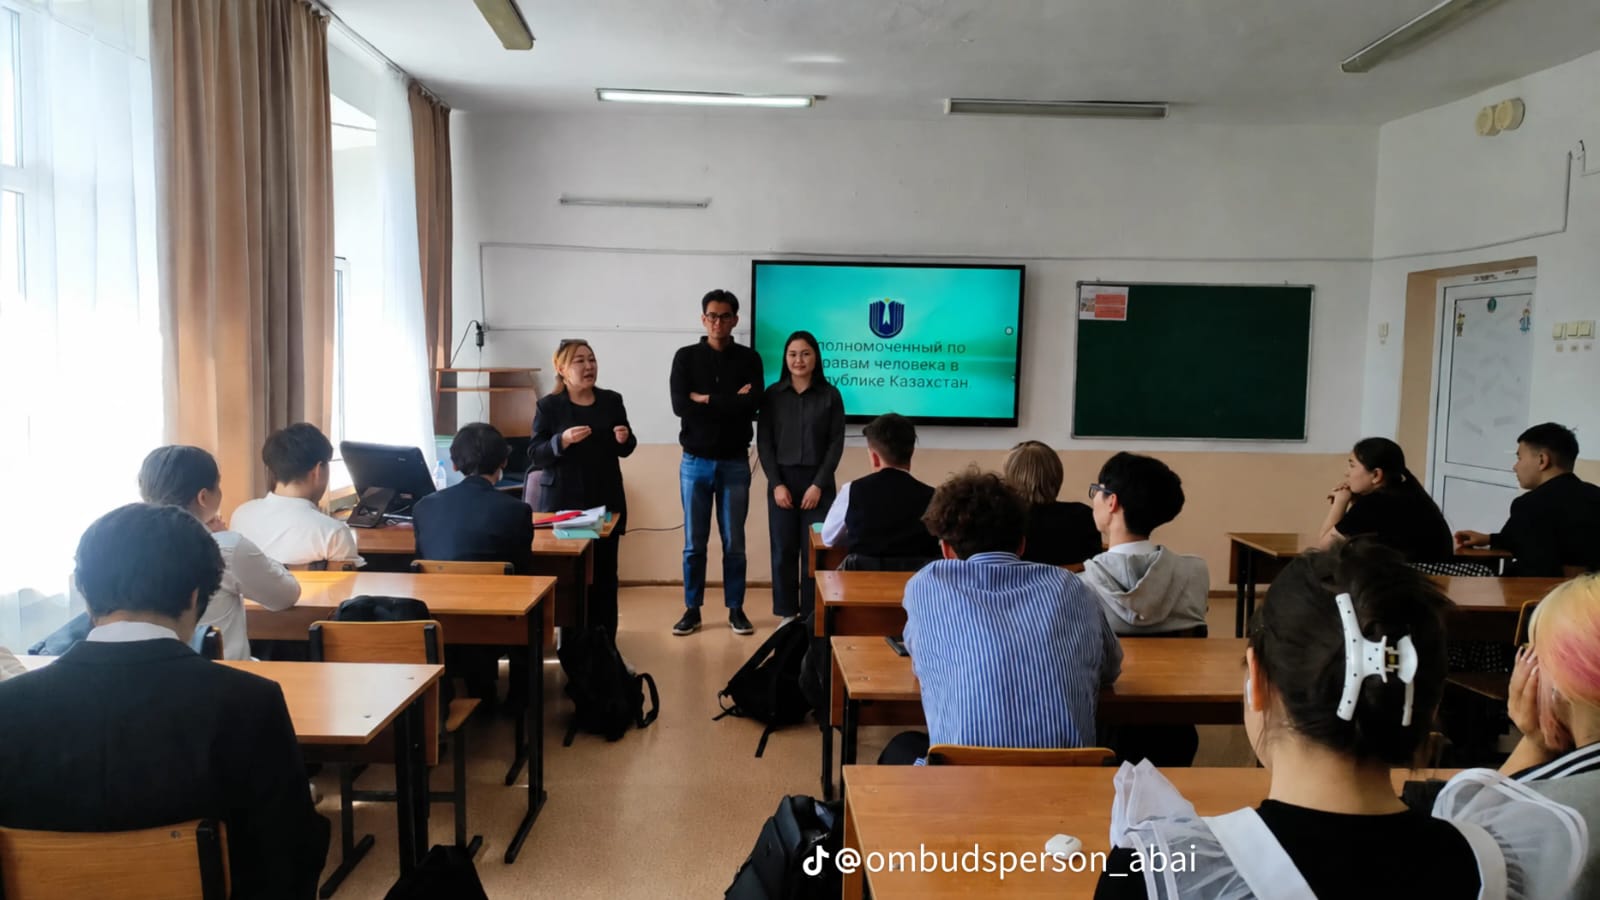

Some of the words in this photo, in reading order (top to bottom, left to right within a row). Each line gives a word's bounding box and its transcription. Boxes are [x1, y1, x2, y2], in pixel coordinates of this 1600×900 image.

[818, 341, 943, 353] полномоченный
[947, 343, 967, 354] по
[822, 359, 870, 369] равам
[874, 360, 946, 371] человека
[950, 361, 960, 372] в
[889, 375, 969, 389] Казахстан
